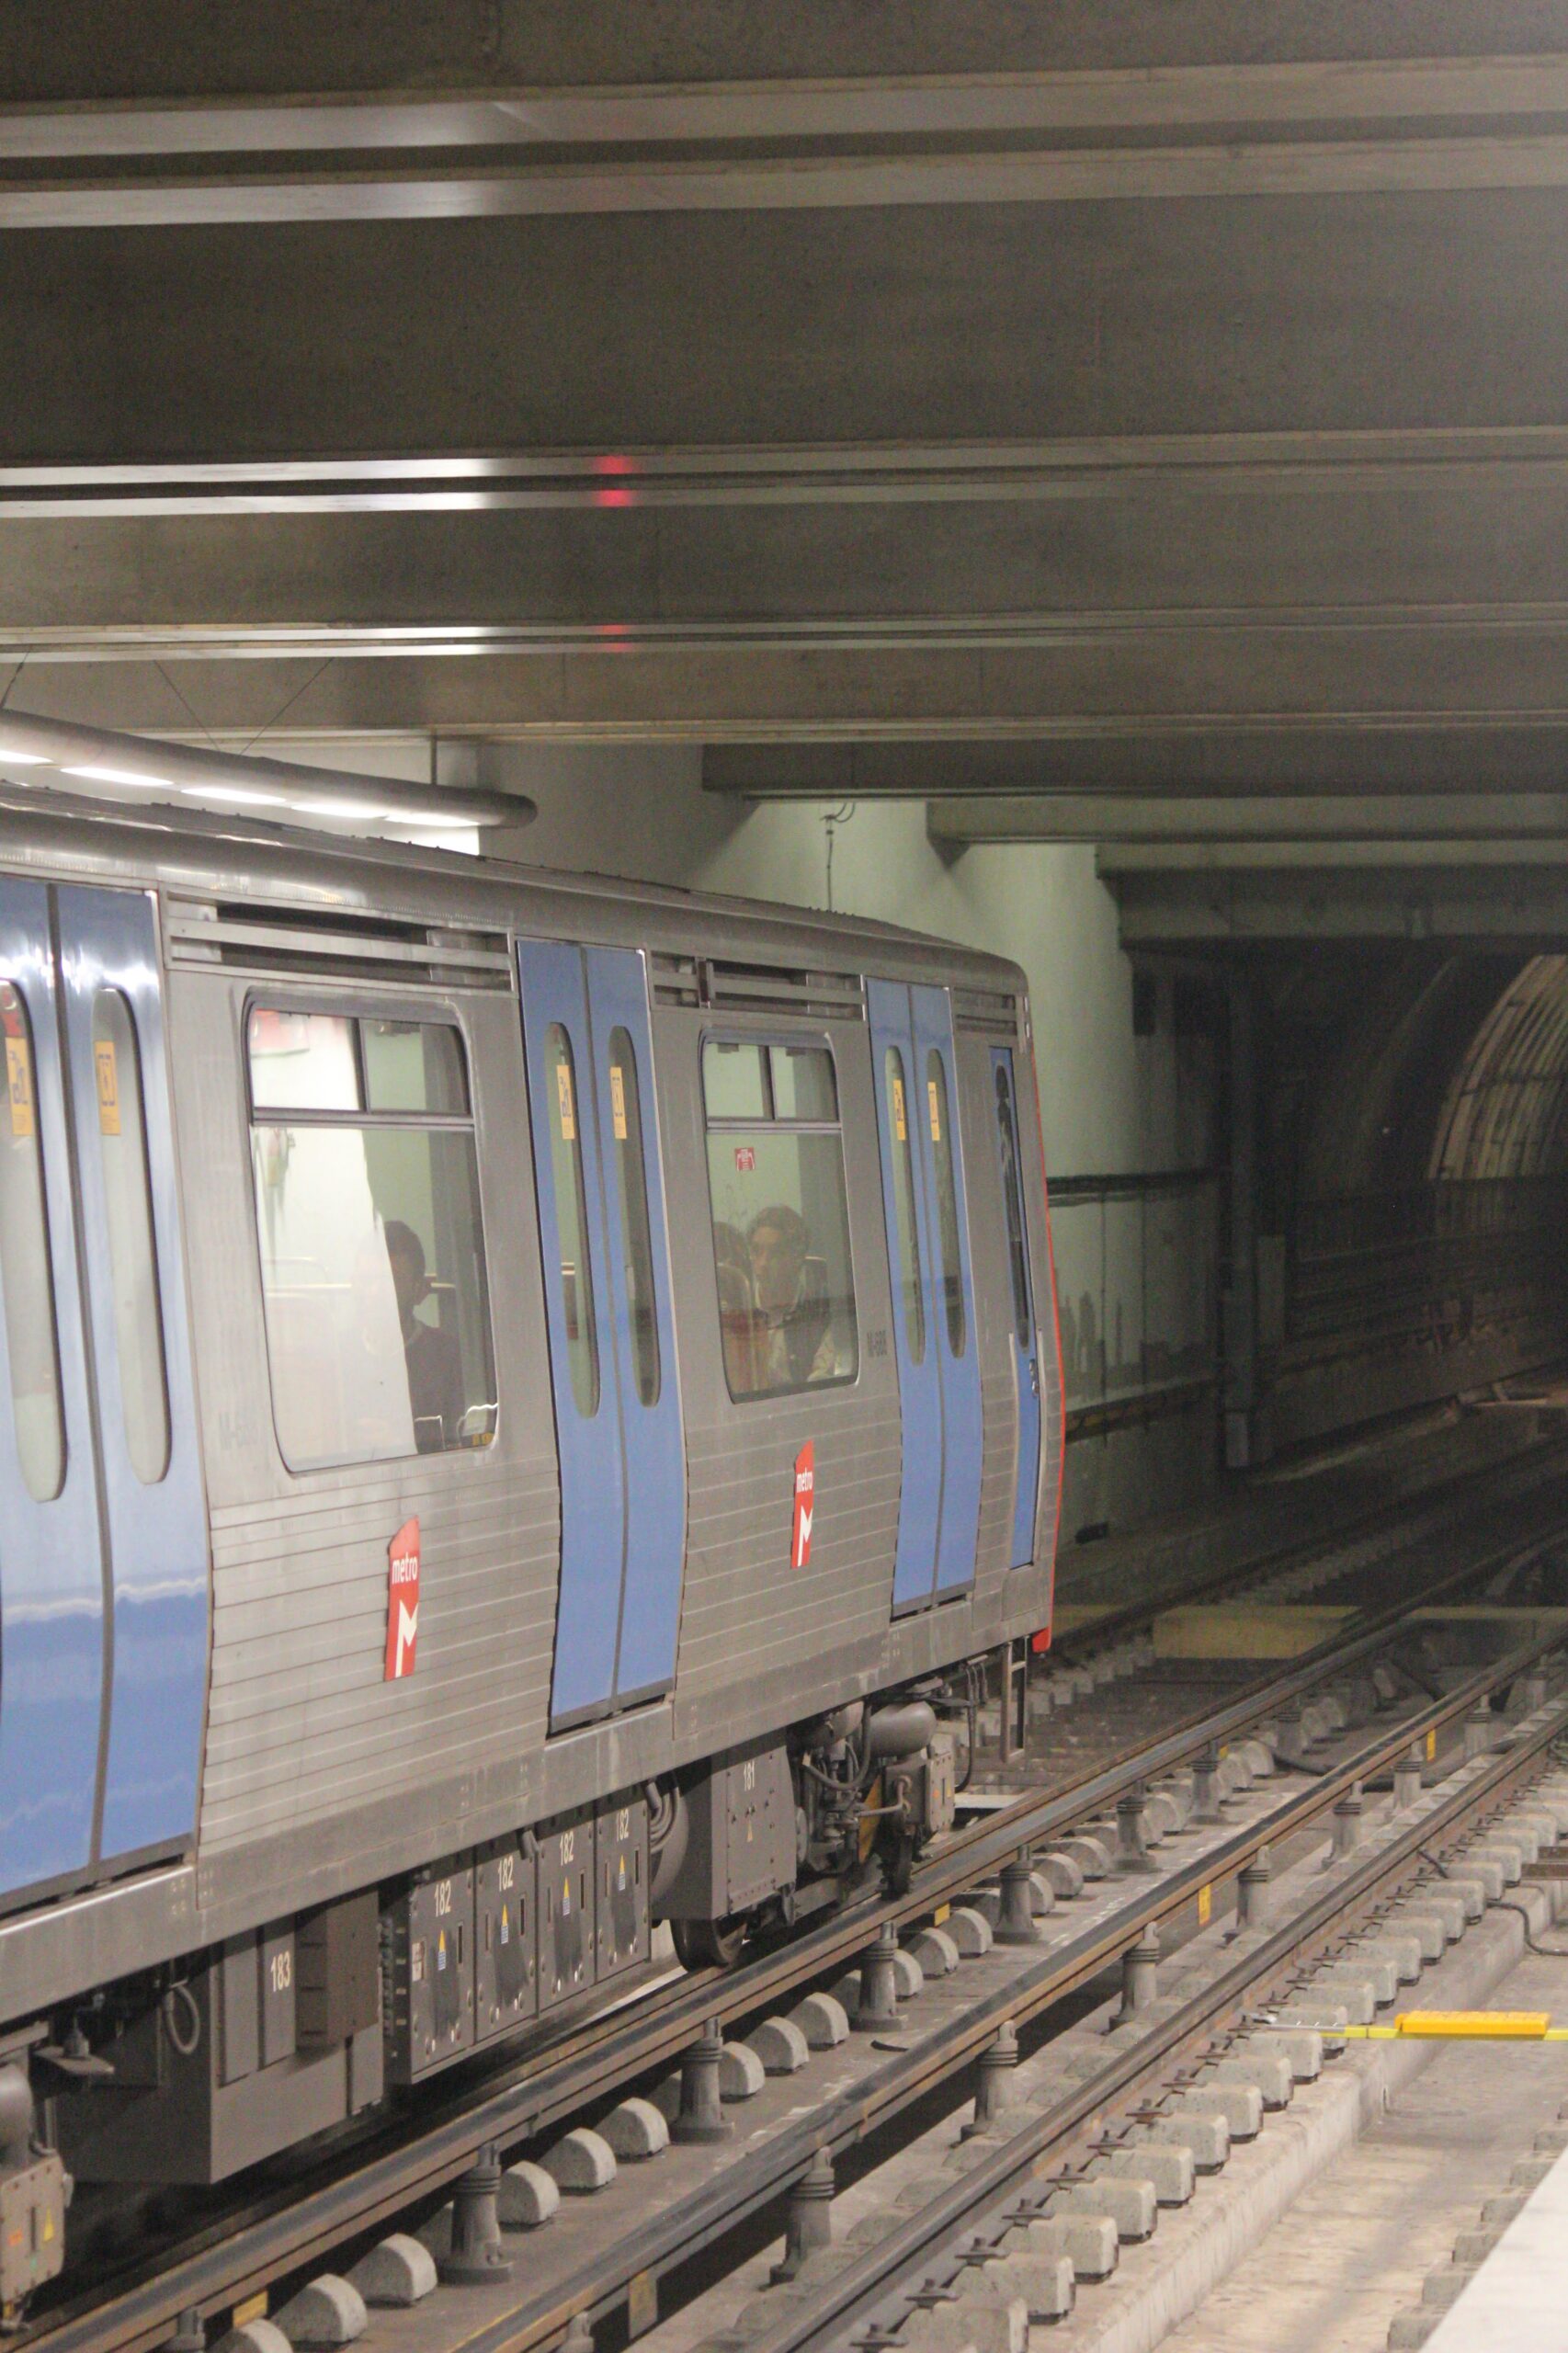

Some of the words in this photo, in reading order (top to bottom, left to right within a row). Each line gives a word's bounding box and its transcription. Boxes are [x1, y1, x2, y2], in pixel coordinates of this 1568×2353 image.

[796, 1467, 813, 1493] metro
[392, 1551, 417, 1584] metro
[743, 1759, 755, 1791] 181
[617, 1808, 630, 1843] 182
[560, 1831, 574, 1866] 182
[497, 1855, 513, 1892] 182
[435, 1880, 450, 1917] 182
[270, 1950, 290, 1992] 183
